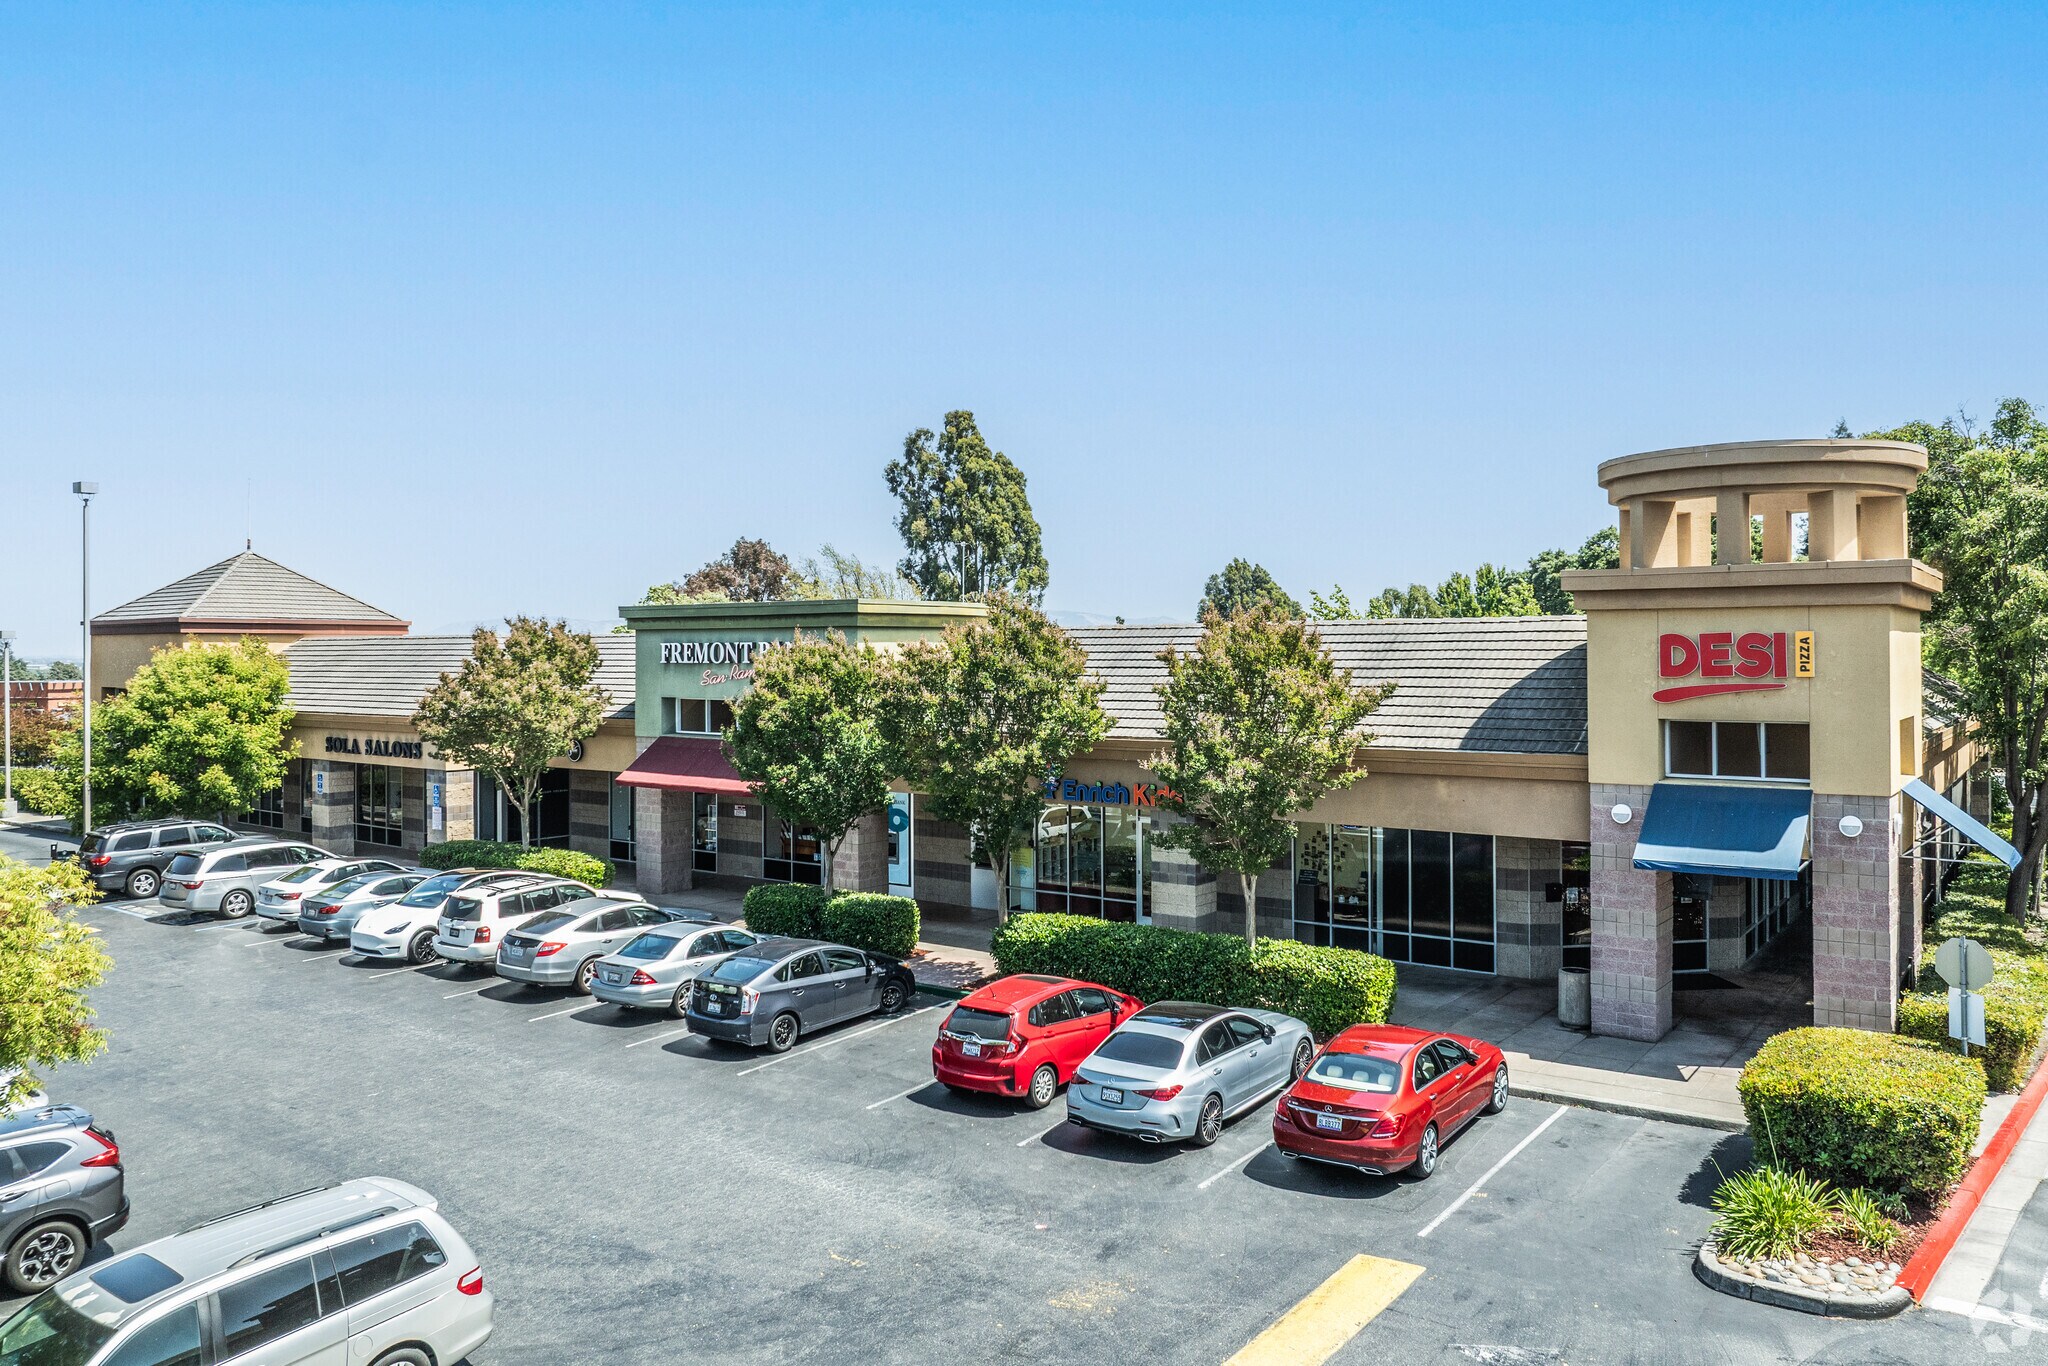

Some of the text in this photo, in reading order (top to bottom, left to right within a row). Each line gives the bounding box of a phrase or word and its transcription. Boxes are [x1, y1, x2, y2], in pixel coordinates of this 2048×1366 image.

[660, 641, 753, 664] FREMONT
[1659, 632, 1788, 678] DESI
[1799, 636, 1810, 673] PIZZA
[700, 664, 756, 686] San Ram
[325, 736, 422, 759] SOLA SALONS
[1062, 779, 1129, 806] Enrich
